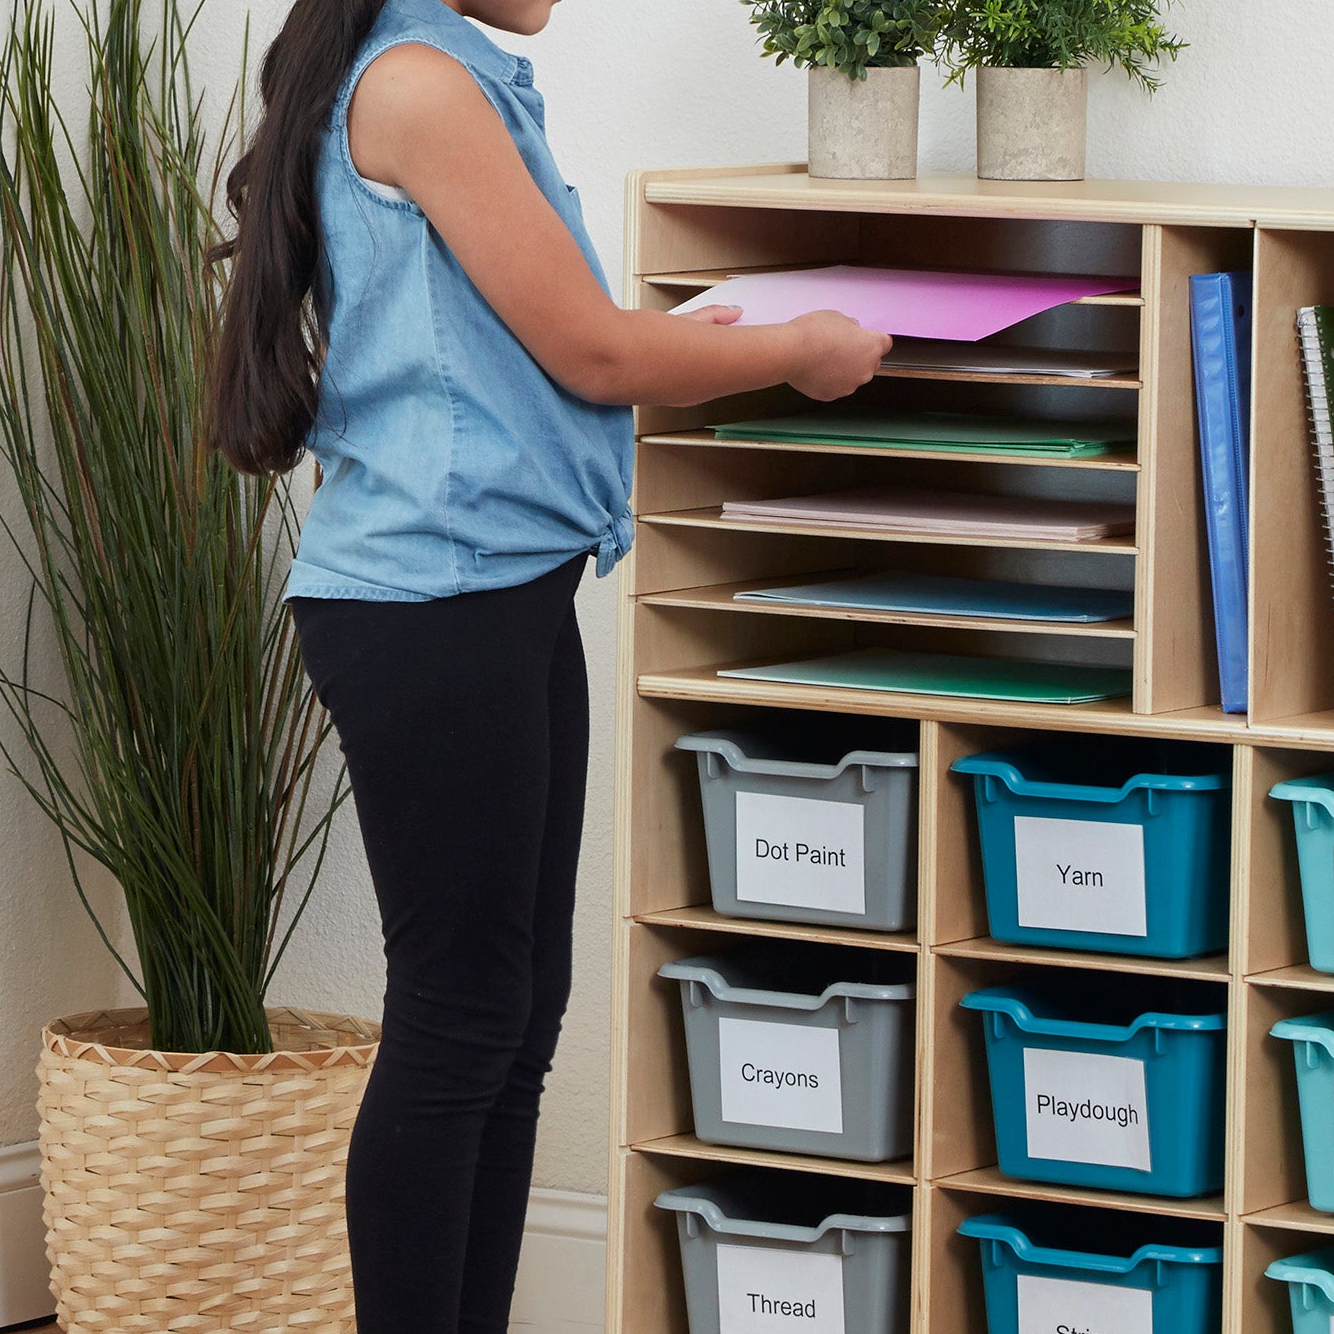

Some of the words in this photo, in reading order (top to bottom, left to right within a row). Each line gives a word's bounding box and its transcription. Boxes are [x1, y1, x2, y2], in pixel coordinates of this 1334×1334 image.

[756, 839, 789, 860] Dot
[796, 843, 845, 867] Paint
[1057, 865, 1102, 886] Yarn
[742, 1063, 818, 1089] Crayons
[1038, 1095, 1138, 1127] Playdough
[747, 1293, 815, 1318] Thread
